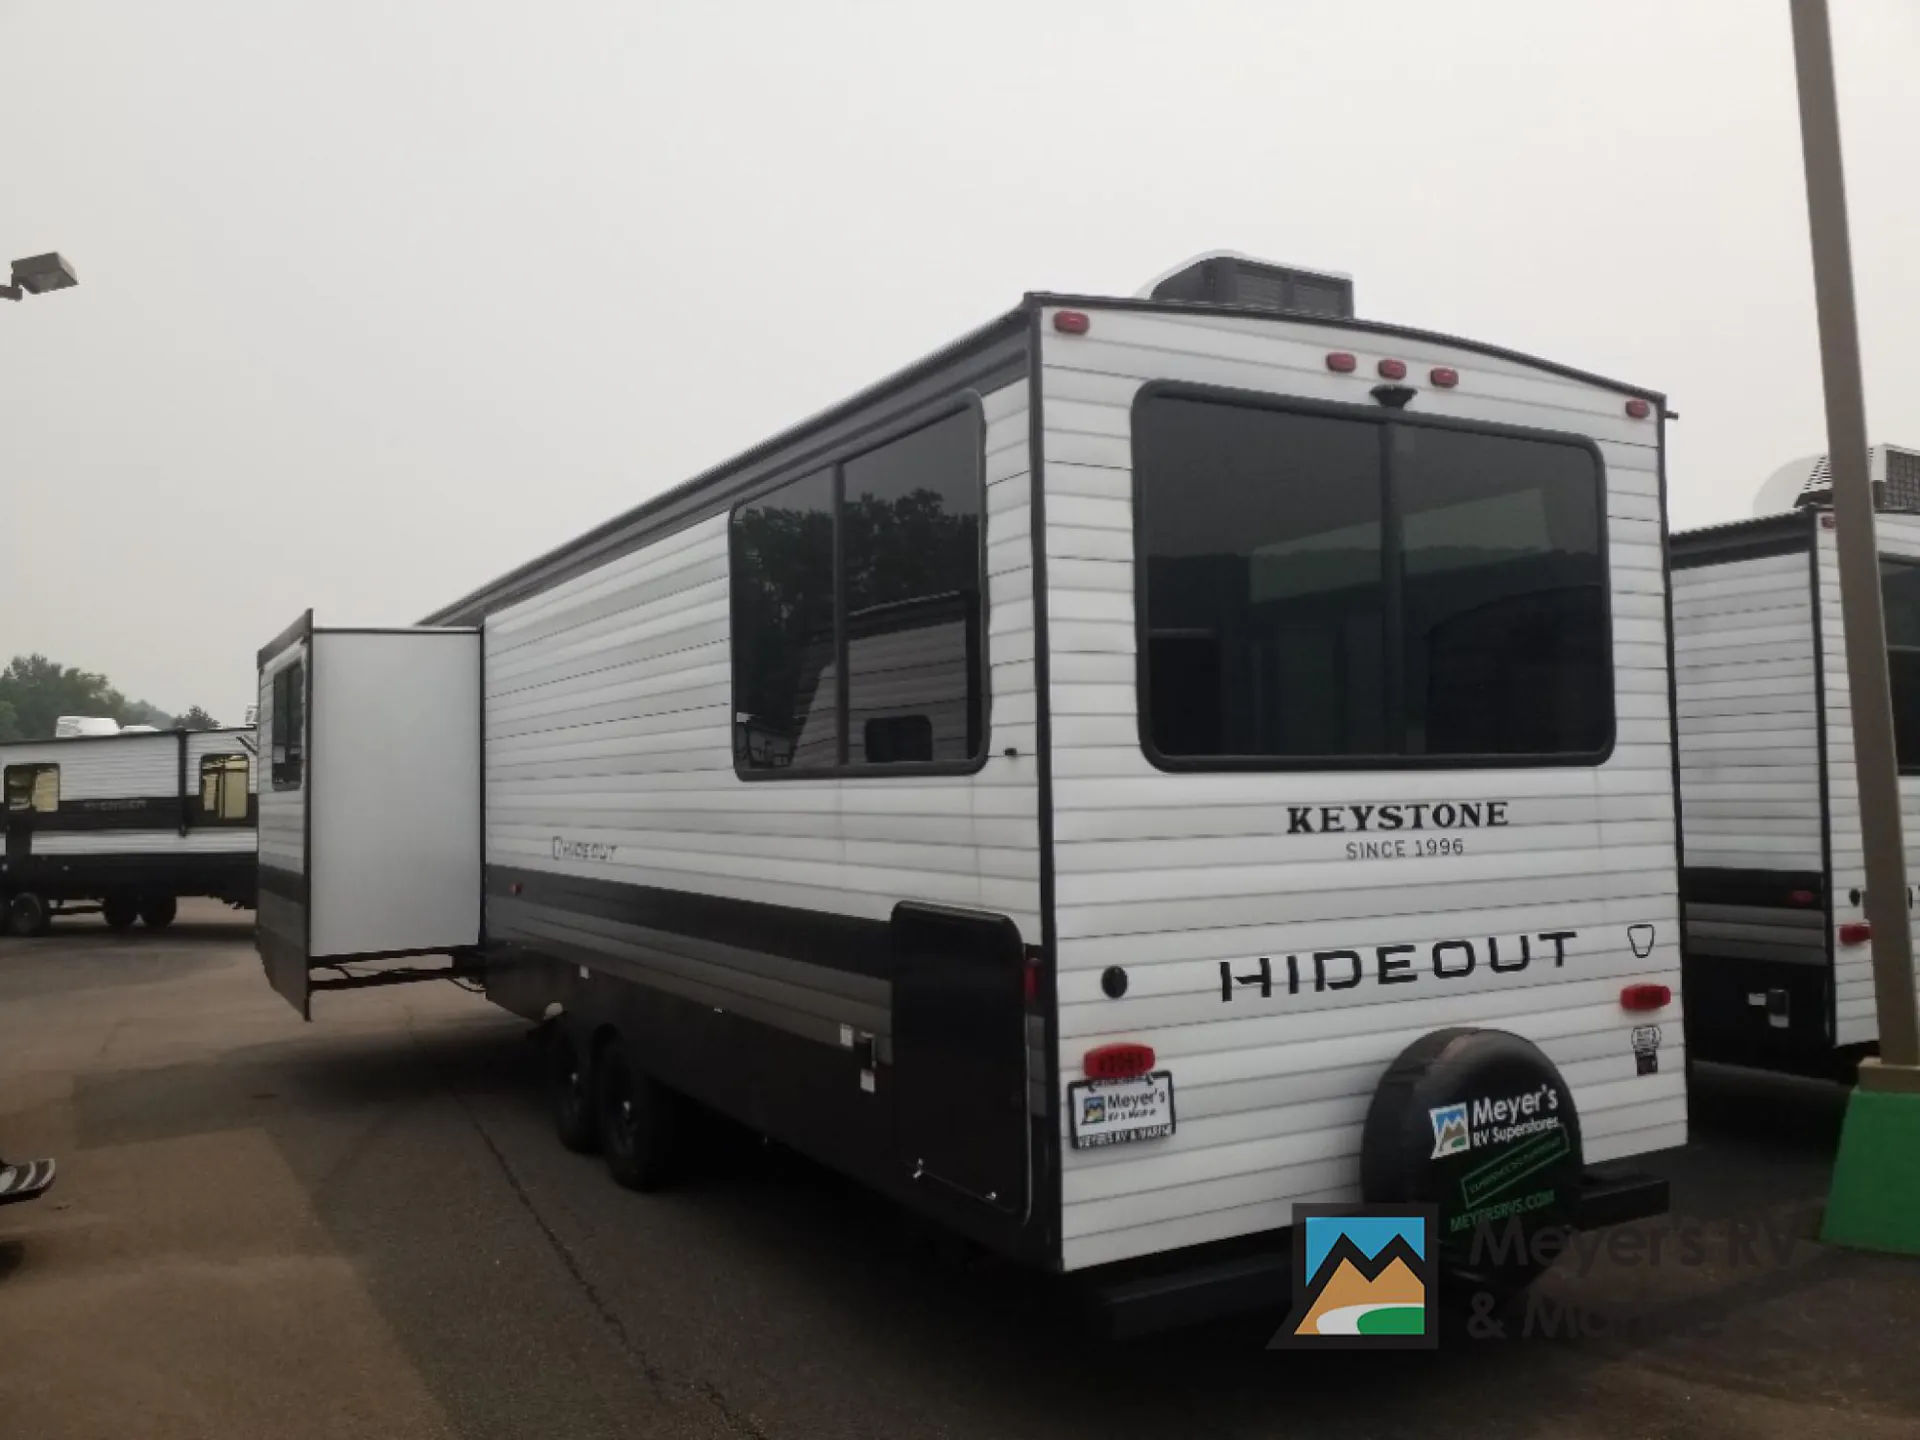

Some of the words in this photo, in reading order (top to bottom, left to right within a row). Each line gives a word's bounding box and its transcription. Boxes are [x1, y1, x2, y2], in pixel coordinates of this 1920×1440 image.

[1287, 801, 1509, 834] KEYSTONE
[1345, 839, 1406, 861] SINCE
[1415, 837, 1464, 857] 1996
[1219, 930, 1578, 1003] HIDEOUT
[1107, 1087, 1166, 1110] Meyer's
[1473, 1083, 1559, 1127] Meyer's
[1473, 1130, 1489, 1147] RV
[1492, 1116, 1560, 1143] Superstores
